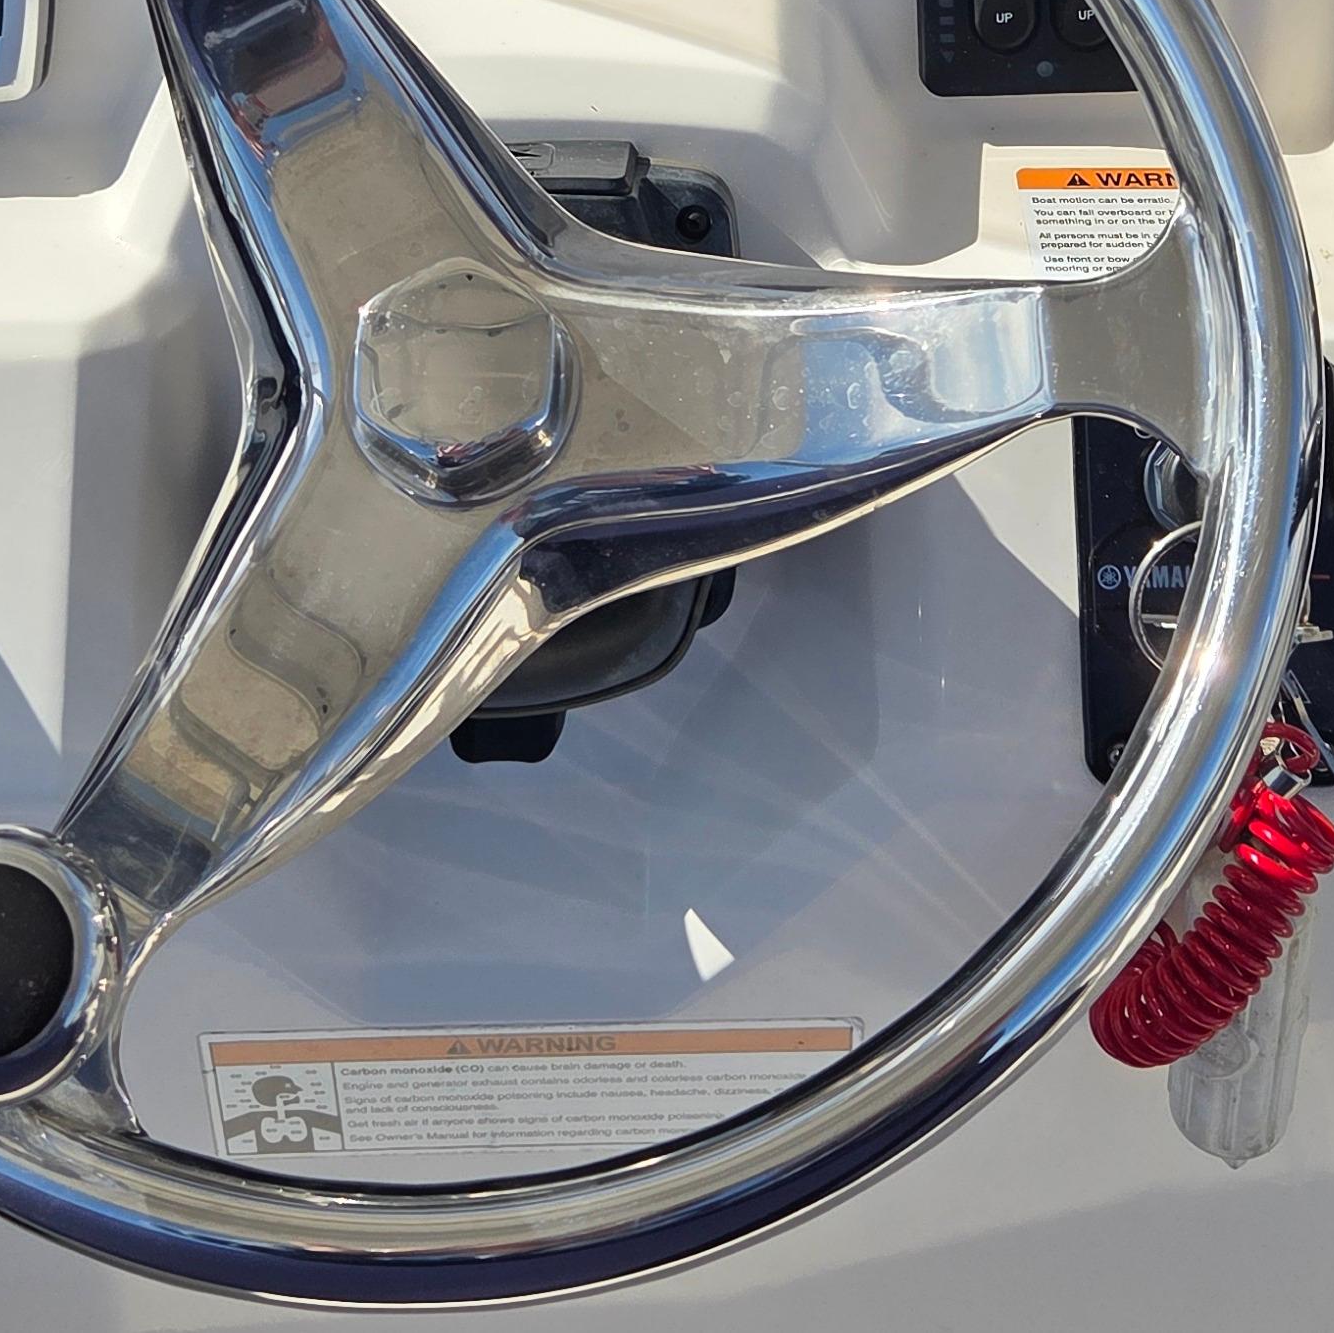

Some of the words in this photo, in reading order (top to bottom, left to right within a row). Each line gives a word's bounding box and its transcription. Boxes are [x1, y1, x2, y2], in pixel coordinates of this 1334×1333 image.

[995, 12, 1013, 24] UP
[1078, 9, 1094, 21] UP
[1059, 196, 1095, 204] motion
[1121, 196, 1134, 204] be
[476, 1035, 616, 1054] WARNING
